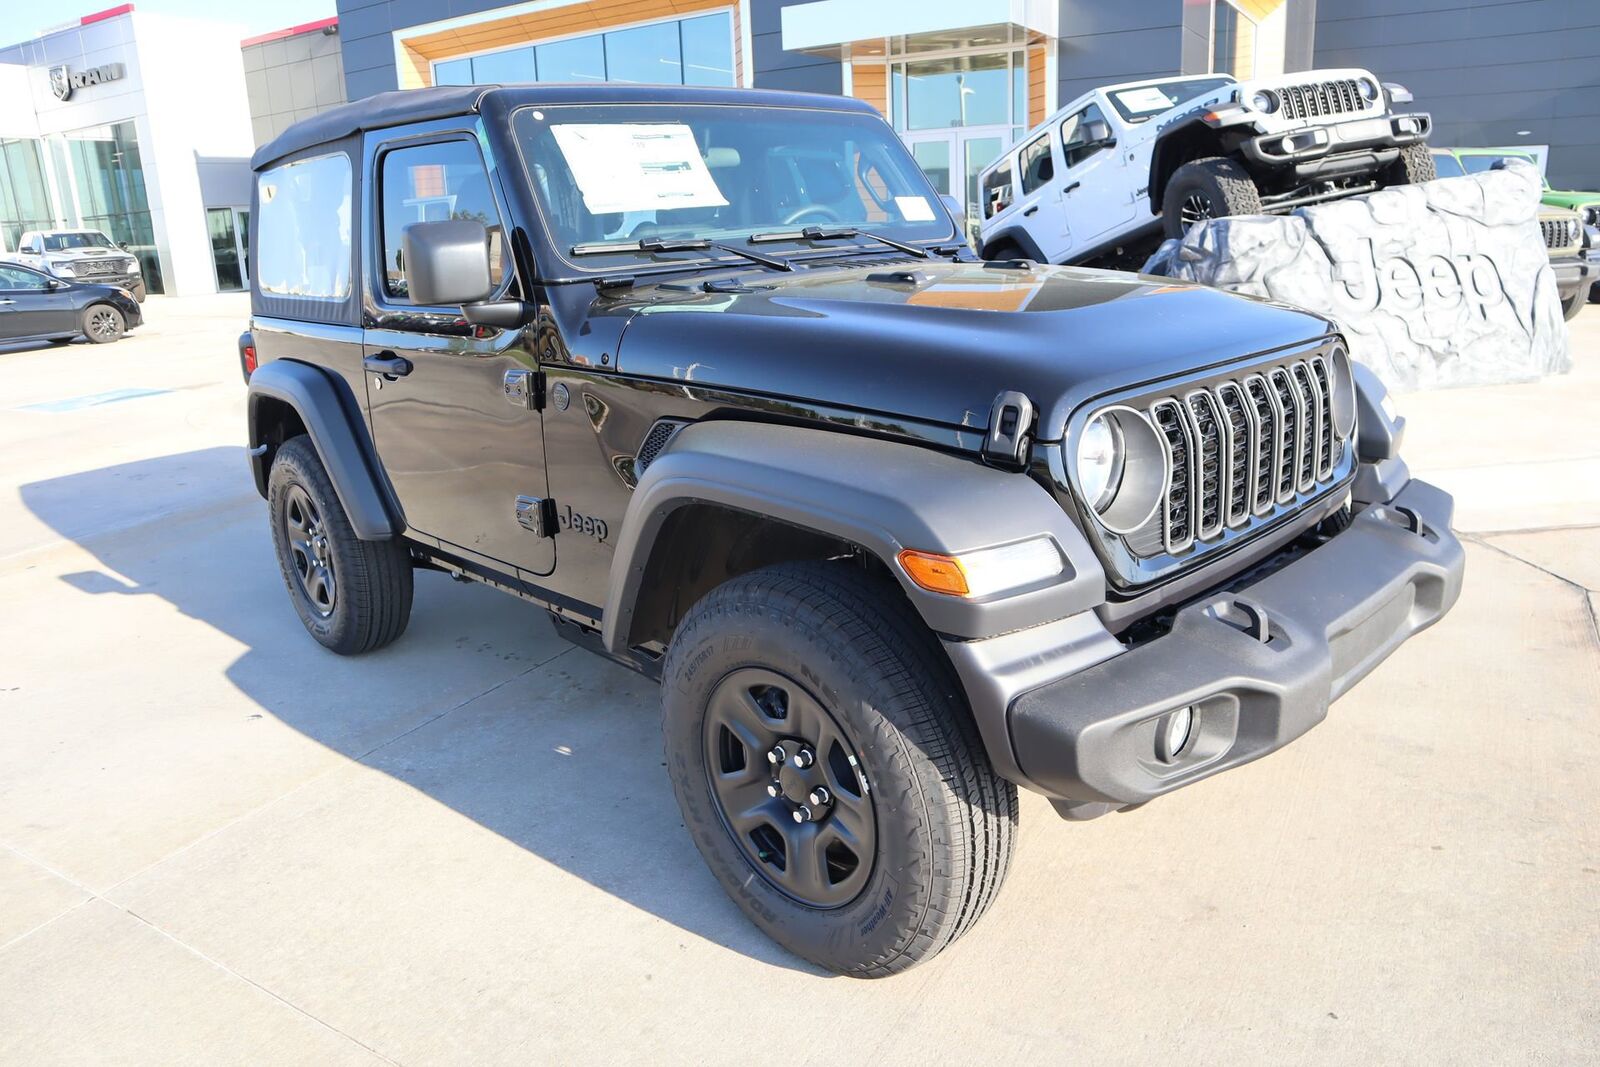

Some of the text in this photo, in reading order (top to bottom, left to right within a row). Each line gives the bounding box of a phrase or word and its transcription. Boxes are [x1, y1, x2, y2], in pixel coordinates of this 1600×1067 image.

[70, 63, 123, 88] RAM
[1331, 237, 1504, 321] Jeep
[559, 504, 608, 543] Jeep
[860, 886, 893, 937] All-Weather
